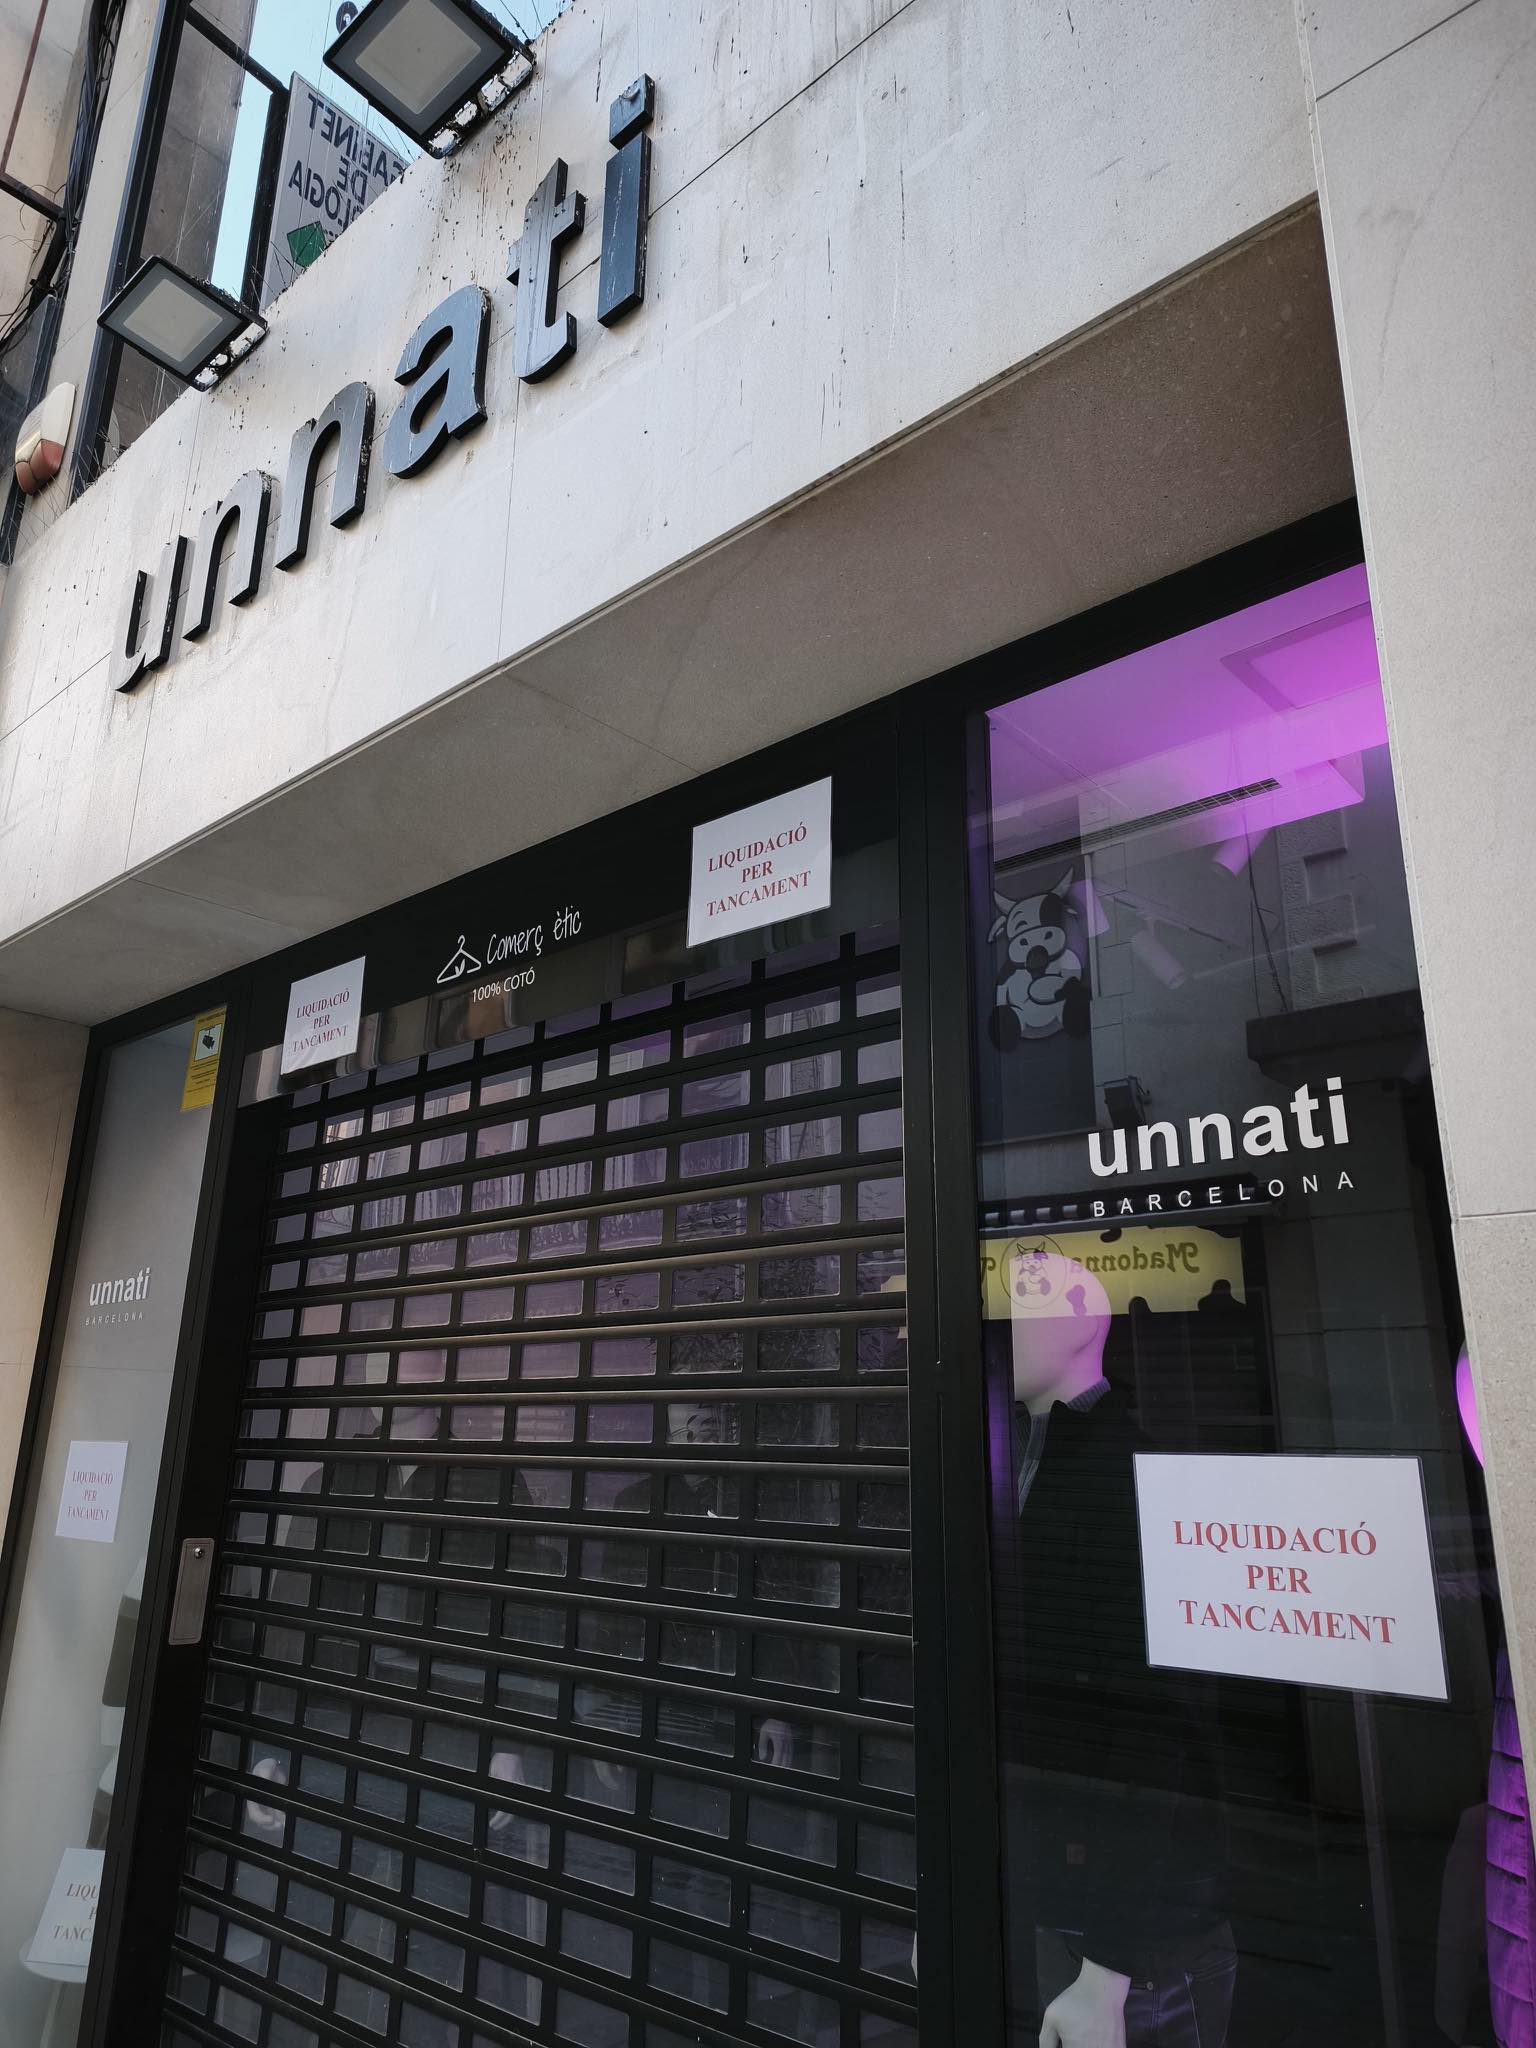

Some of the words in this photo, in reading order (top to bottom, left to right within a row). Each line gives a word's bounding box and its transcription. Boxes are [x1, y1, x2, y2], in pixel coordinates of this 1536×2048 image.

[109, 72, 655, 694] unnati
[708, 822, 807, 873] LIQUIDACIÓ
[741, 860, 773, 883] PER
[706, 870, 811, 916] TANCAMENT
[487, 925, 543, 964] Comerç
[553, 905, 582, 940] ètic
[472, 981, 501, 1003] 100%
[503, 966, 535, 992] COTÓ
[296, 988, 350, 1018] LIQUIDACIÓ
[293, 1025, 347, 1053] TANCAMENT
[313, 1014, 330, 1039] PER
[1088, 1076, 1349, 1177] unnati
[1093, 1171, 1354, 1217] BARCELONA
[89, 1267, 151, 1306] unnati
[85, 1312, 143, 1326] BARCELONA
[72, 1470, 114, 1485] LIQUIDACIÓ
[84, 1489, 97, 1502] PER
[67, 1506, 110, 1521] TANCAMENT
[1172, 1520, 1377, 1556] LIQUIDACIÓ
[1245, 1564, 1313, 1594] PER
[1178, 1599, 1397, 1644] TANCAMENT
[66, 1883, 100, 1901] LIQU
[54, 1925, 94, 1942] TANC
